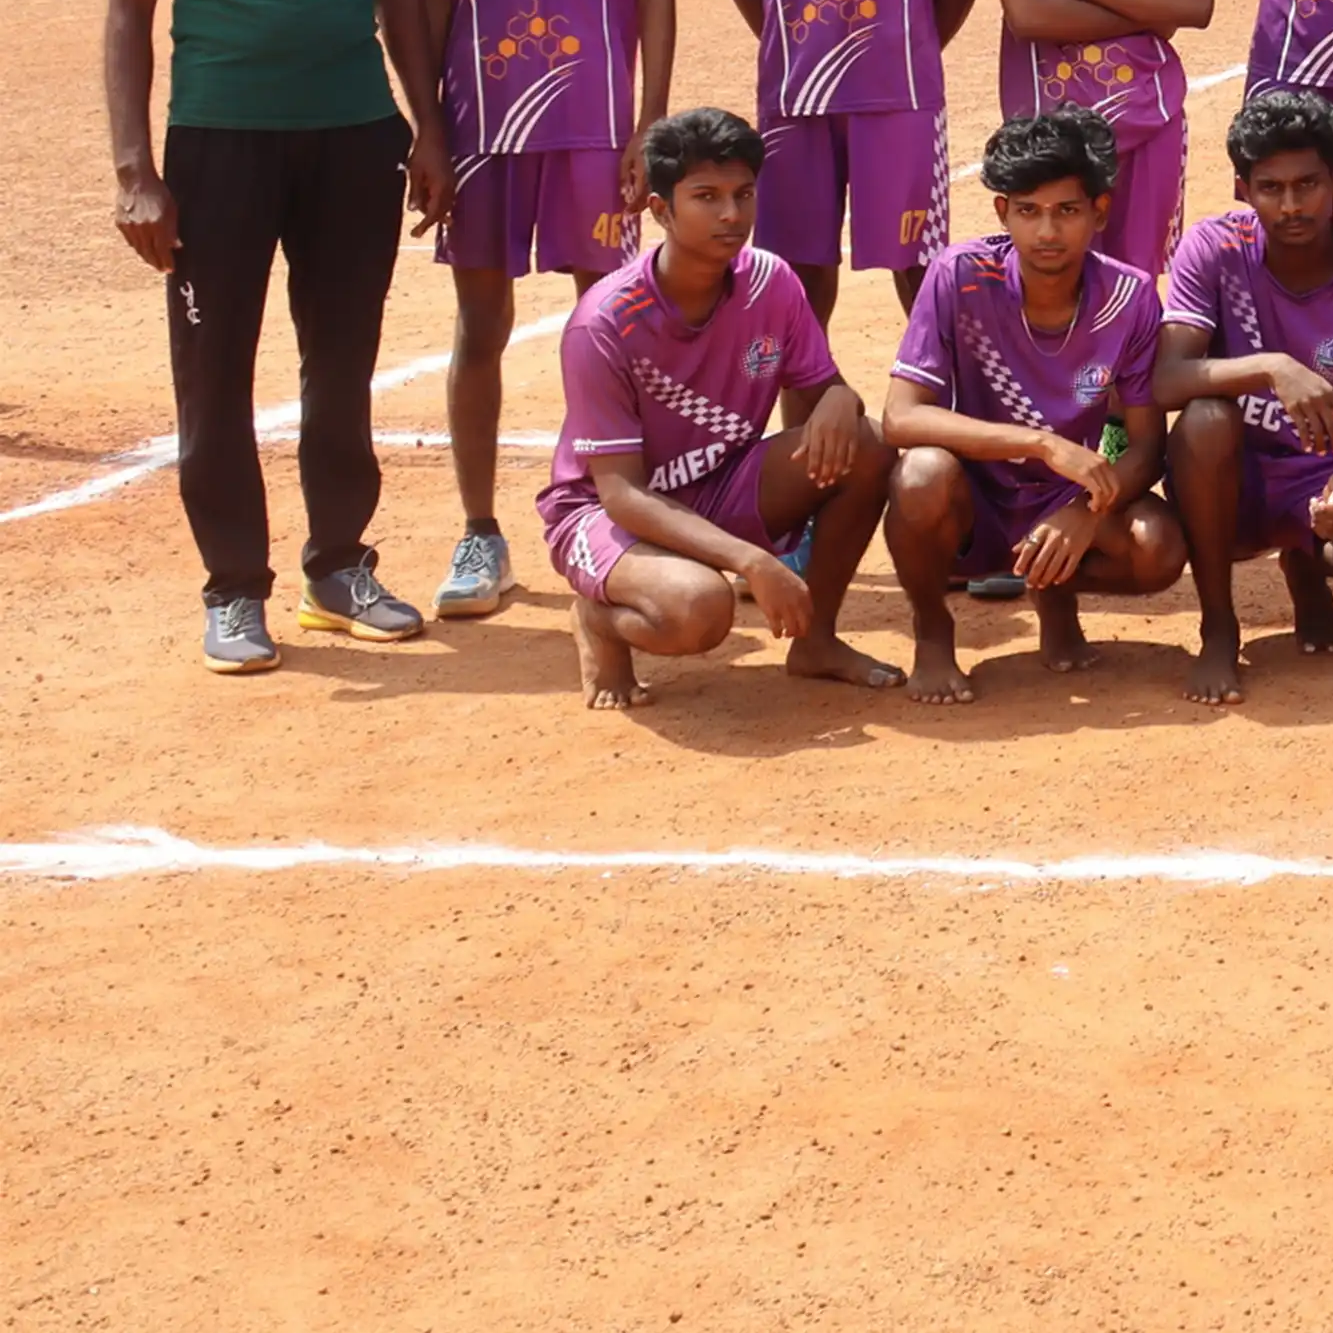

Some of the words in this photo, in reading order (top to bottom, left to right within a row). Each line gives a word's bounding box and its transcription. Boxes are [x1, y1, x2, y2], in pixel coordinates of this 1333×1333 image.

[592, 212, 622, 248] 46
[900, 209, 927, 246] 07
[648, 441, 727, 492] AHEC
